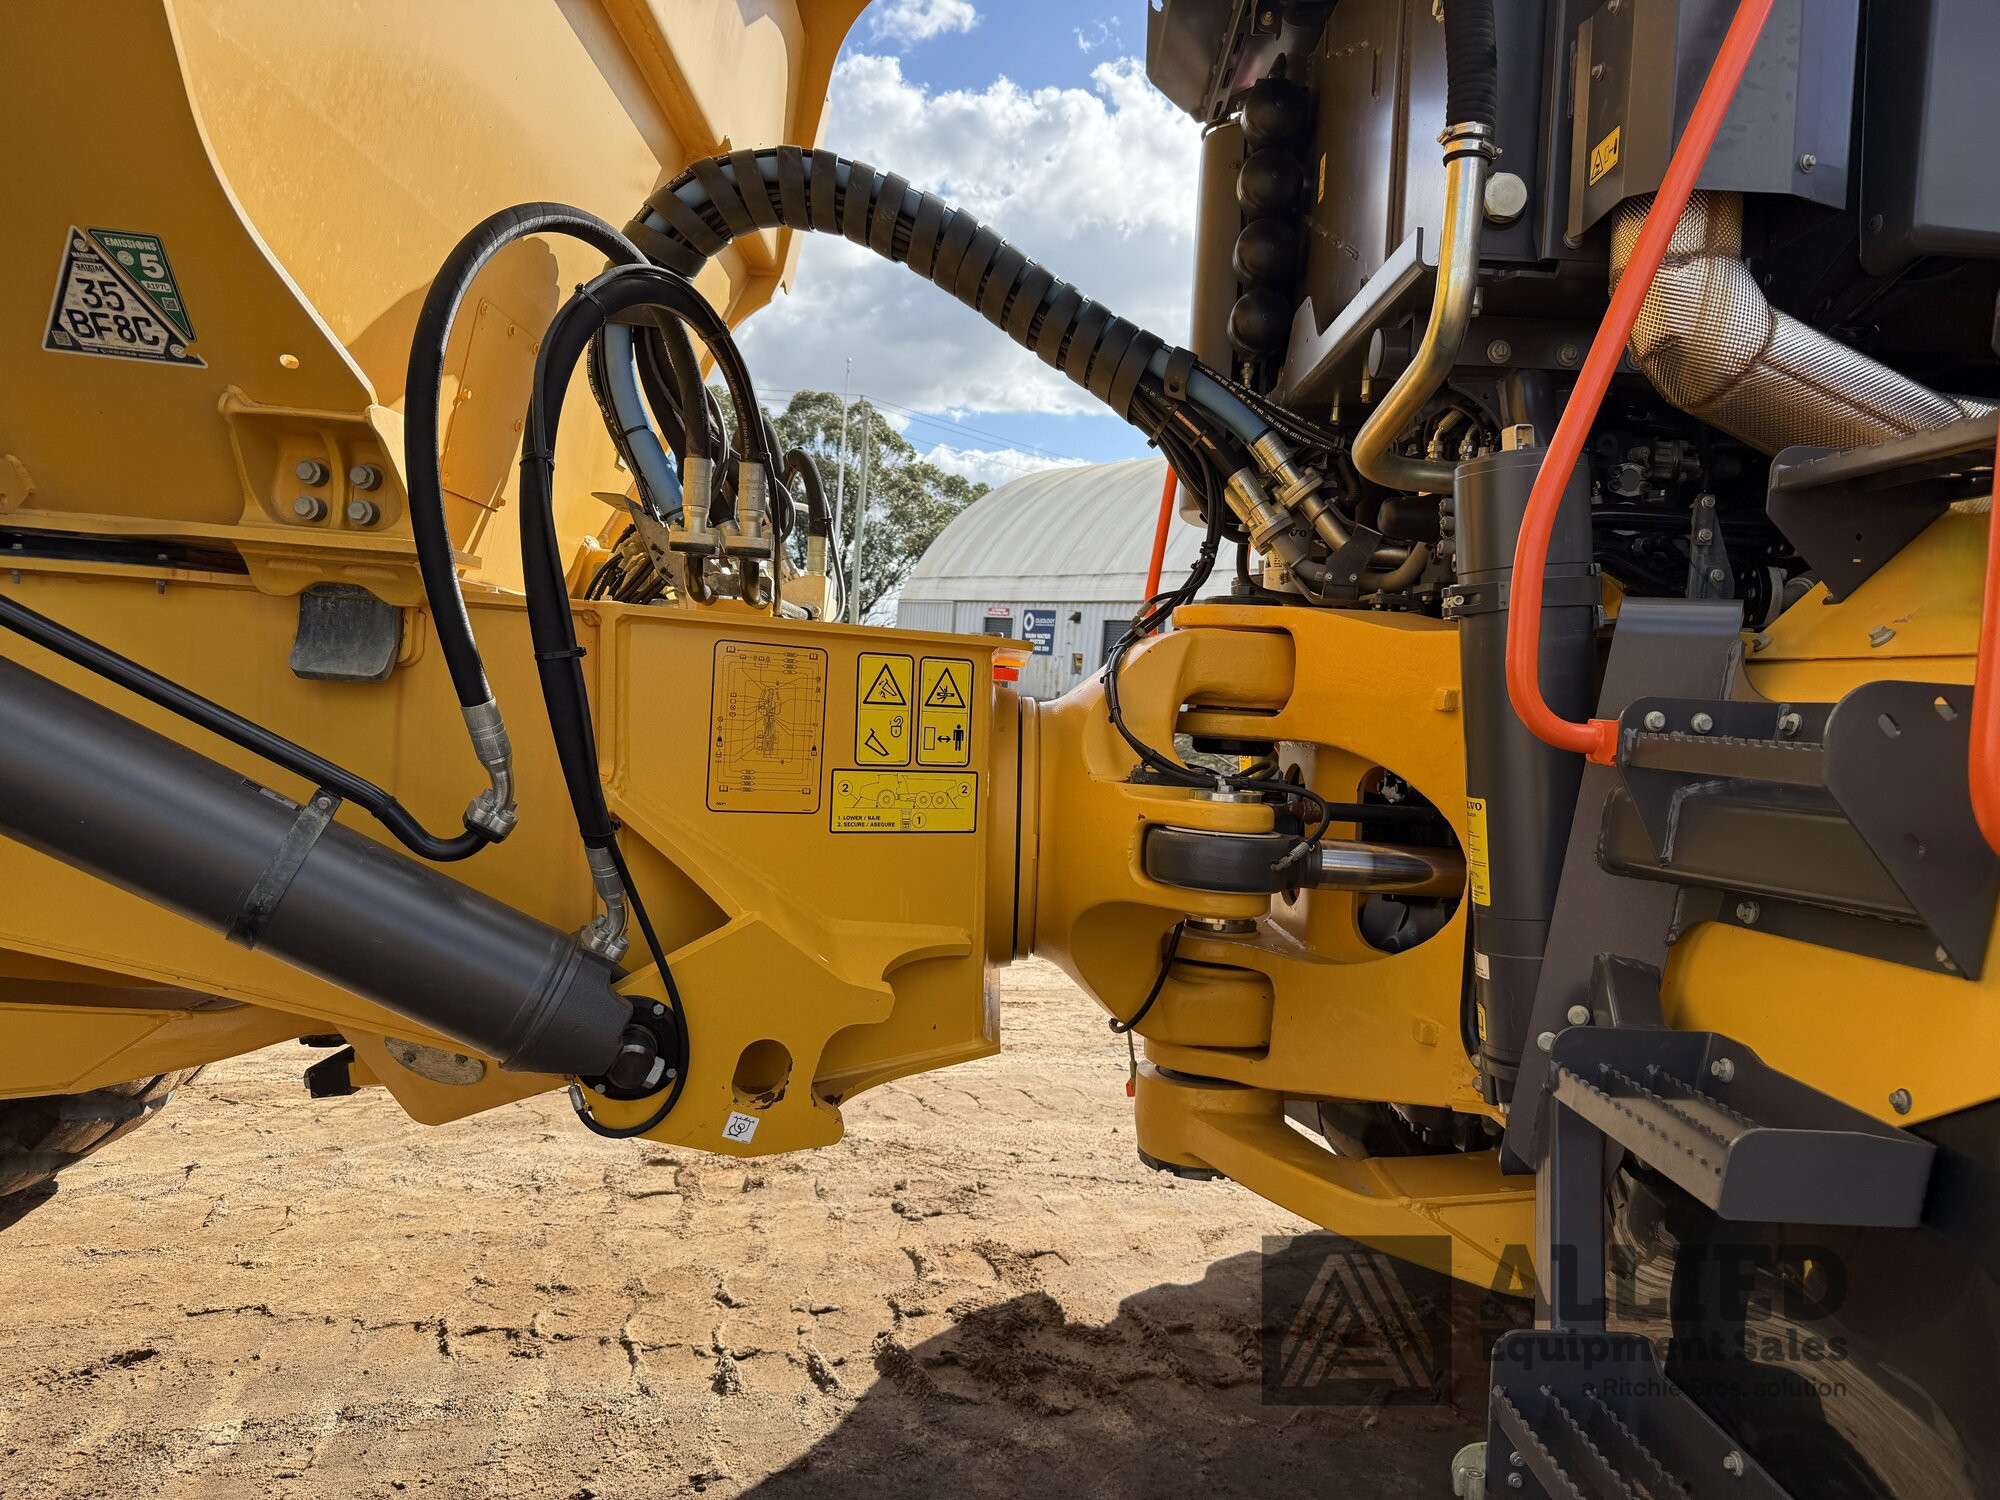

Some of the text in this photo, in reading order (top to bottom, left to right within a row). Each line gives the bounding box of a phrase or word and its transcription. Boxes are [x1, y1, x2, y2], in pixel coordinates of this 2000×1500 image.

[139, 253, 165, 279] 5
[75, 277, 125, 312] 35
[65, 308, 160, 346] BF8C
[842, 783, 849, 793] 2
[961, 785, 968, 794] 2
[1466, 800, 1482, 811] LVO
[916, 816, 922, 825] 1
